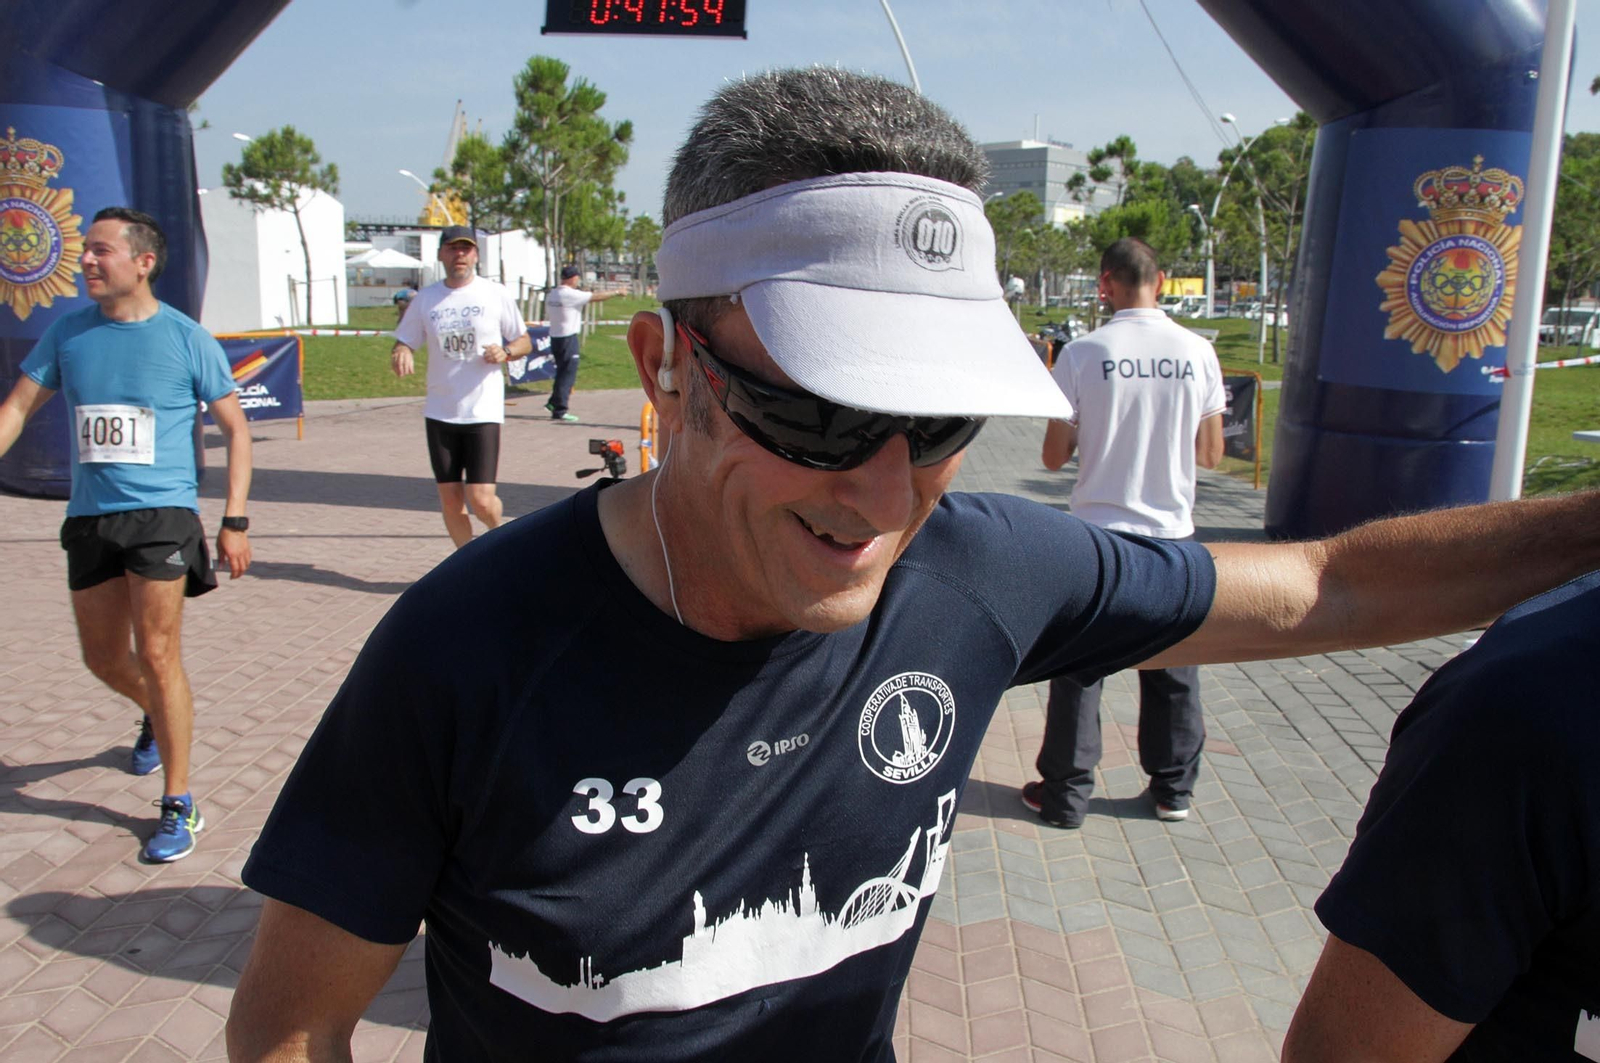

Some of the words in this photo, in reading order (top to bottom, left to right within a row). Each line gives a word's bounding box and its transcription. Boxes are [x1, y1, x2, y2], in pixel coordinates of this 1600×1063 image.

[1459, 239, 1502, 284] NACIONAL
[444, 333, 475, 352] 4069
[1102, 358, 1195, 381] POLICIA
[81, 416, 136, 447] 4081
[908, 675, 953, 715] TRANSPORTES
[882, 751, 938, 780] SEVILLA
[571, 777, 665, 835] 33
